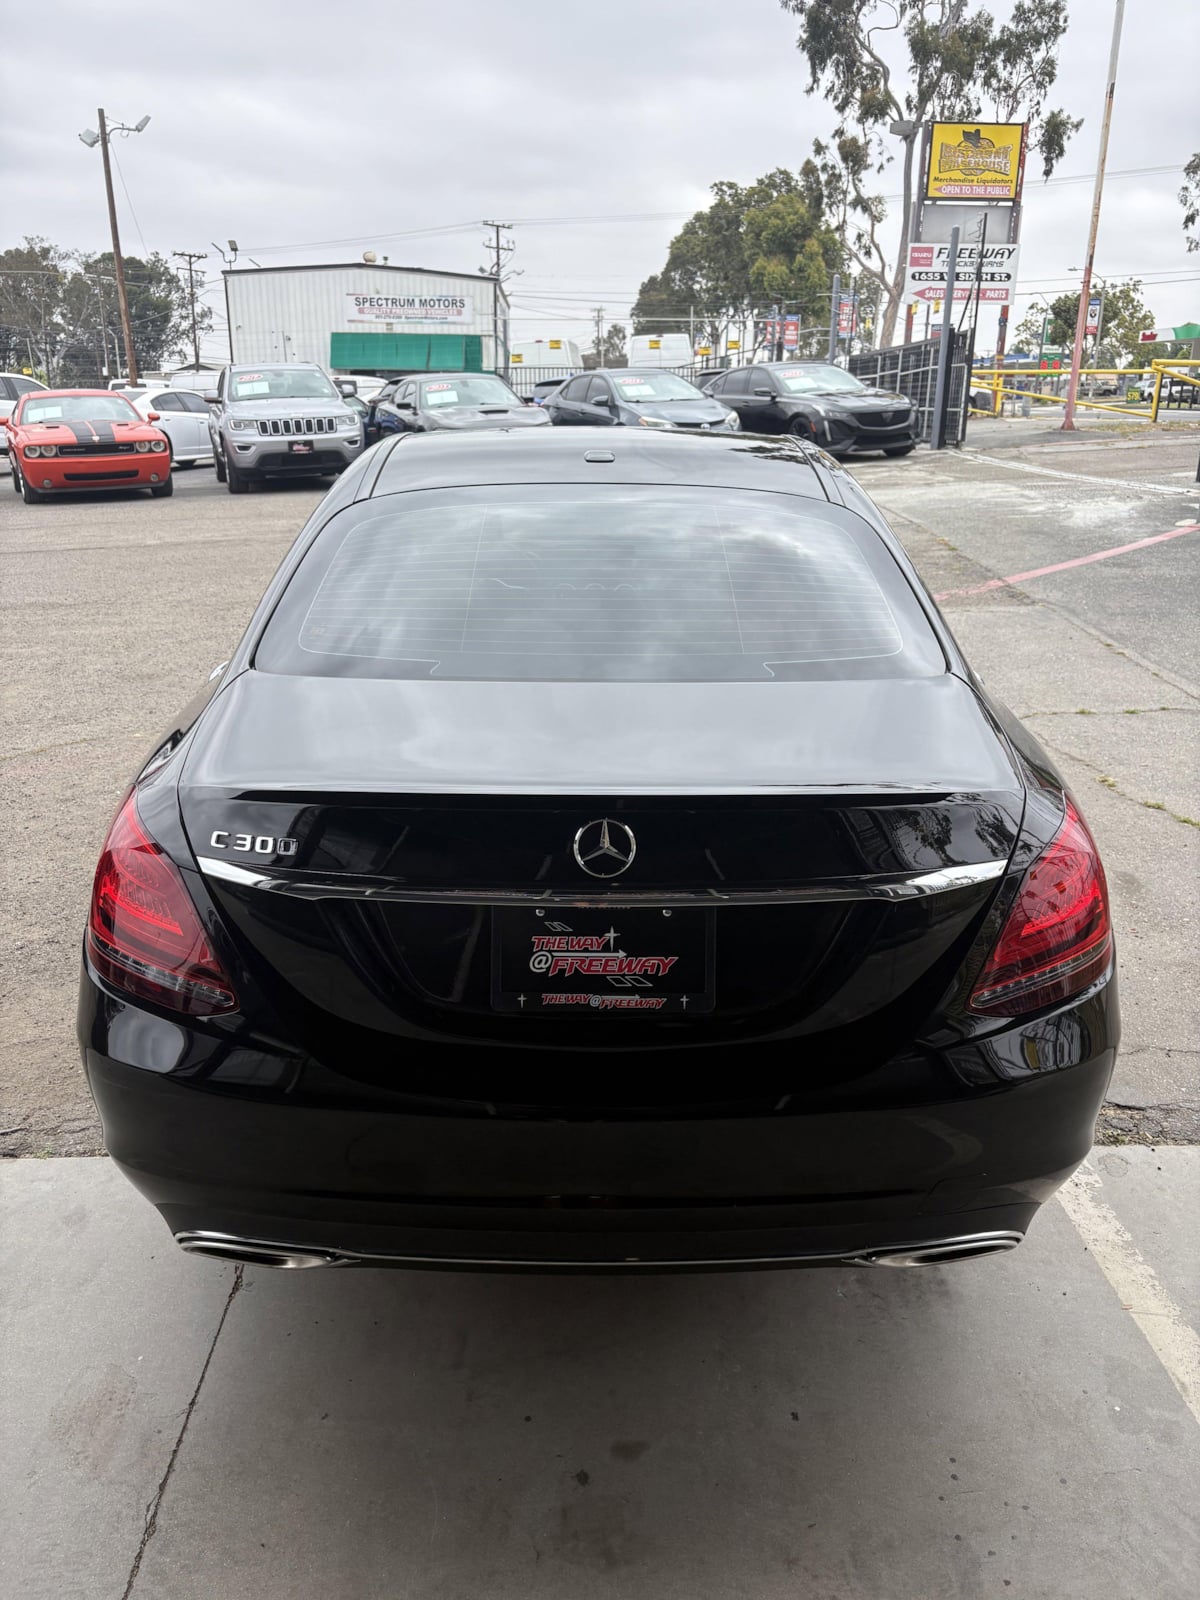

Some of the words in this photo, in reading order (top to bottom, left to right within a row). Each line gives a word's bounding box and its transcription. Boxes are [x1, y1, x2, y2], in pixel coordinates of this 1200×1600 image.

[933, 176, 975, 184] Merchandise
[976, 177, 1013, 185] Liquidators
[941, 185, 960, 194] OPEN
[961, 185, 971, 194] TO
[972, 186, 985, 194] THE
[986, 186, 1010, 195] PUBLIC
[924, 289, 944, 298] SALES
[985, 290, 1007, 298] PARTS
[354, 296, 416, 307] SPECTRUM
[418, 298, 466, 308] MOTORS
[210, 830, 231, 849] C
[232, 833, 299, 856] 300
